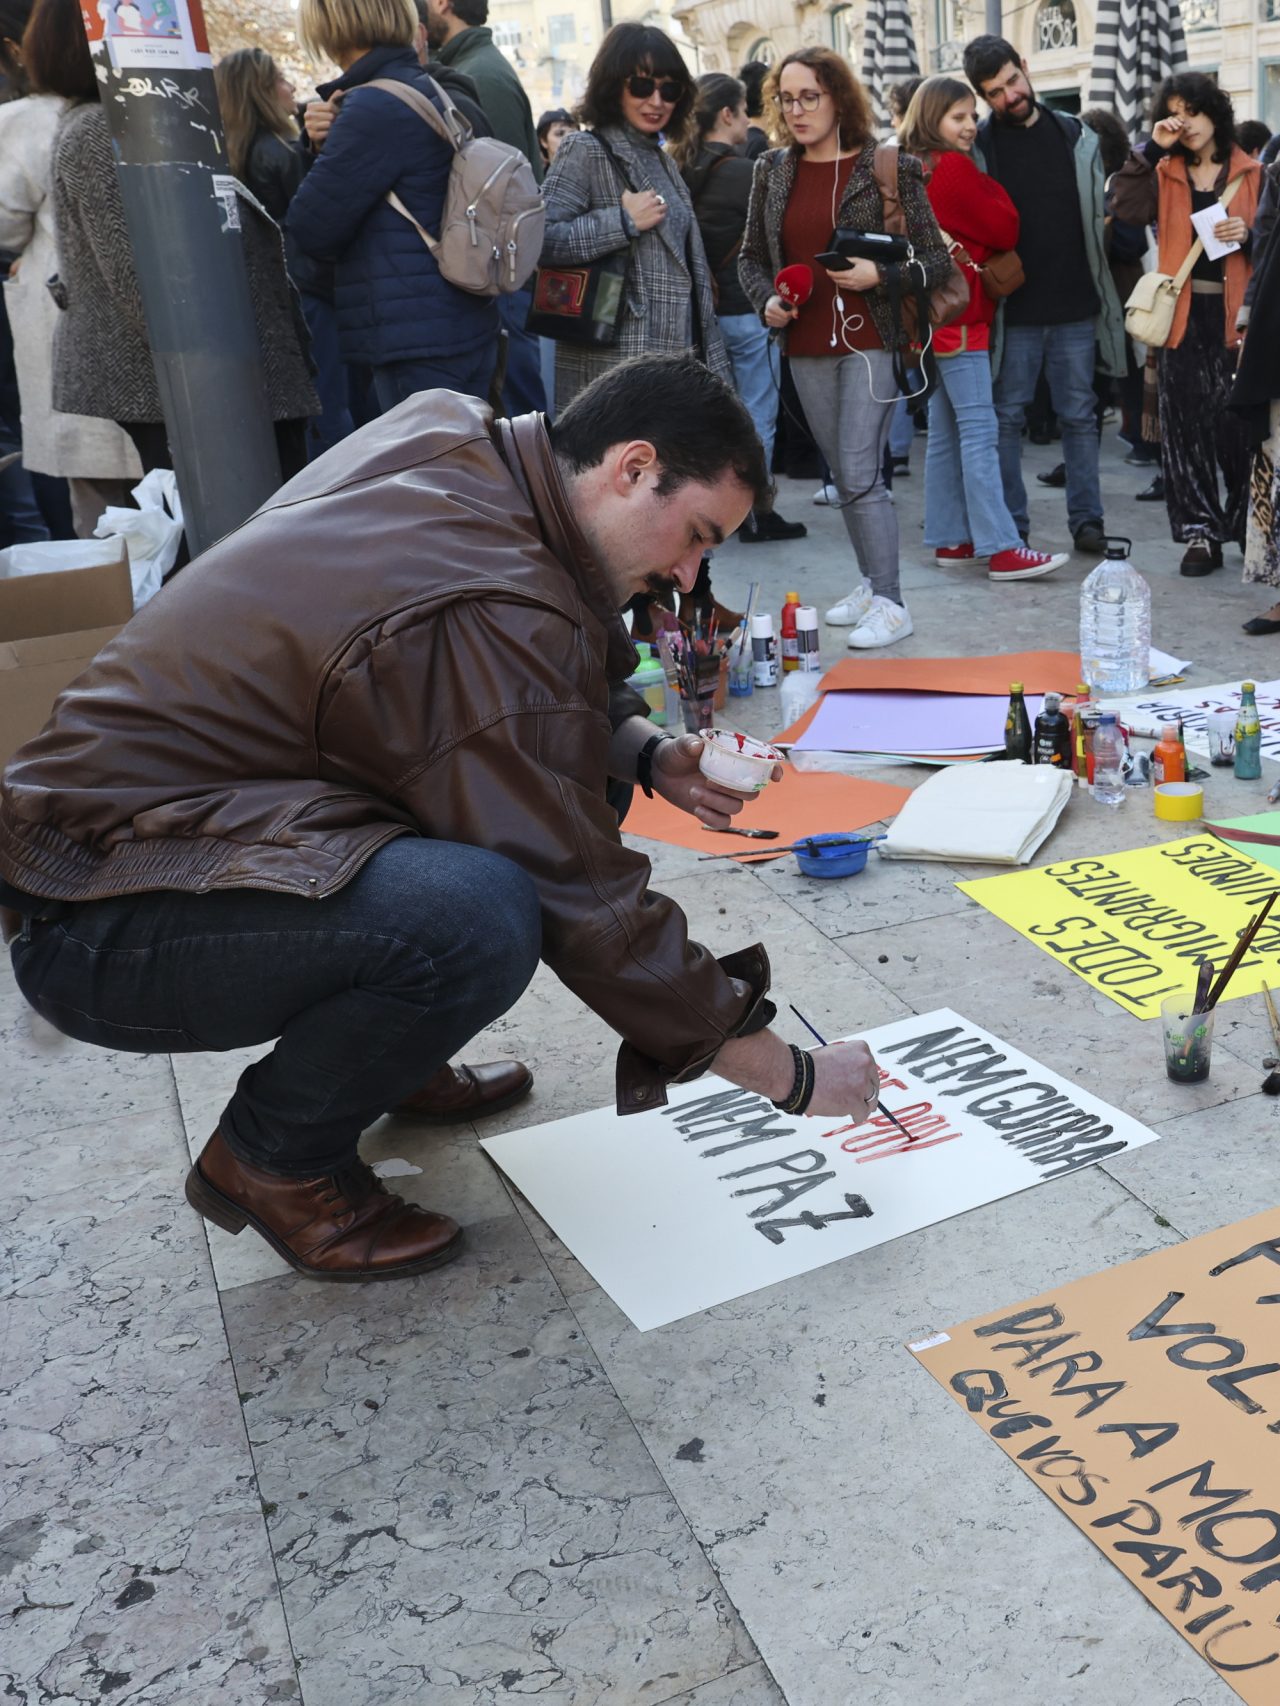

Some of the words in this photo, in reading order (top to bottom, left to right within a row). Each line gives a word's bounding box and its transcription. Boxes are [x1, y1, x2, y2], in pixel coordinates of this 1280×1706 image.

[1028, 916, 1184, 1007] TODES
[1044, 861, 1264, 975] IMIGRANTES
[660, 1088, 797, 1159] NEM
[878, 1026, 1027, 1097] NEM
[962, 1082, 1129, 1179] GUERRA
[717, 1149, 874, 1246] PAZ
[974, 1303, 1132, 1419] PARA
[1096, 1422, 1180, 1461] A
[949, 1368, 1054, 1440] QUE
[1016, 1435, 1111, 1506] VOS
[1090, 1499, 1280, 1672] PARIU
